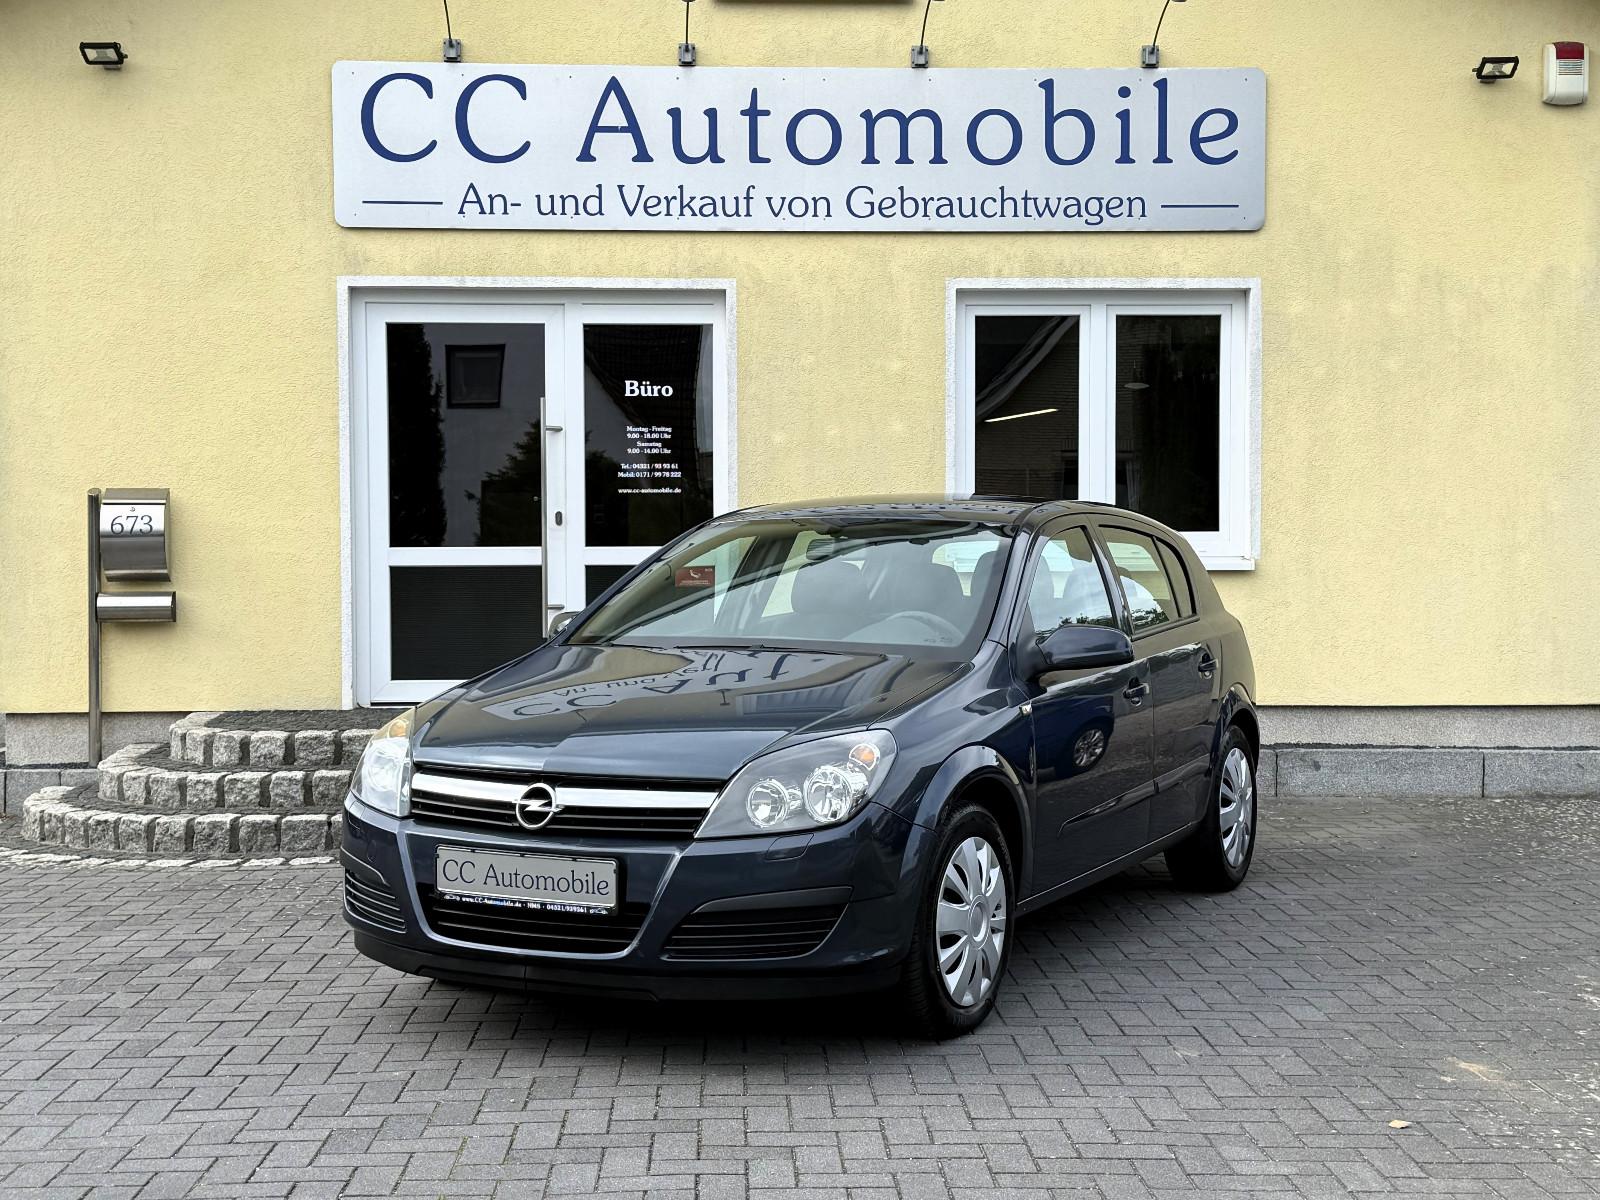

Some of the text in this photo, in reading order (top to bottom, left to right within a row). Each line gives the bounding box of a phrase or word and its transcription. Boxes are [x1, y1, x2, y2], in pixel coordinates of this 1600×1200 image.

[361, 72, 1240, 166] CC Automobile
[457, 181, 1148, 226] An- und Verkauf von Gebrauchtwagen
[624, 379, 674, 397] Büro
[626, 425, 648, 433] Montag
[652, 425, 673, 433] Freitag
[110, 514, 154, 535] 673
[442, 859, 610, 896] CC Automobile
